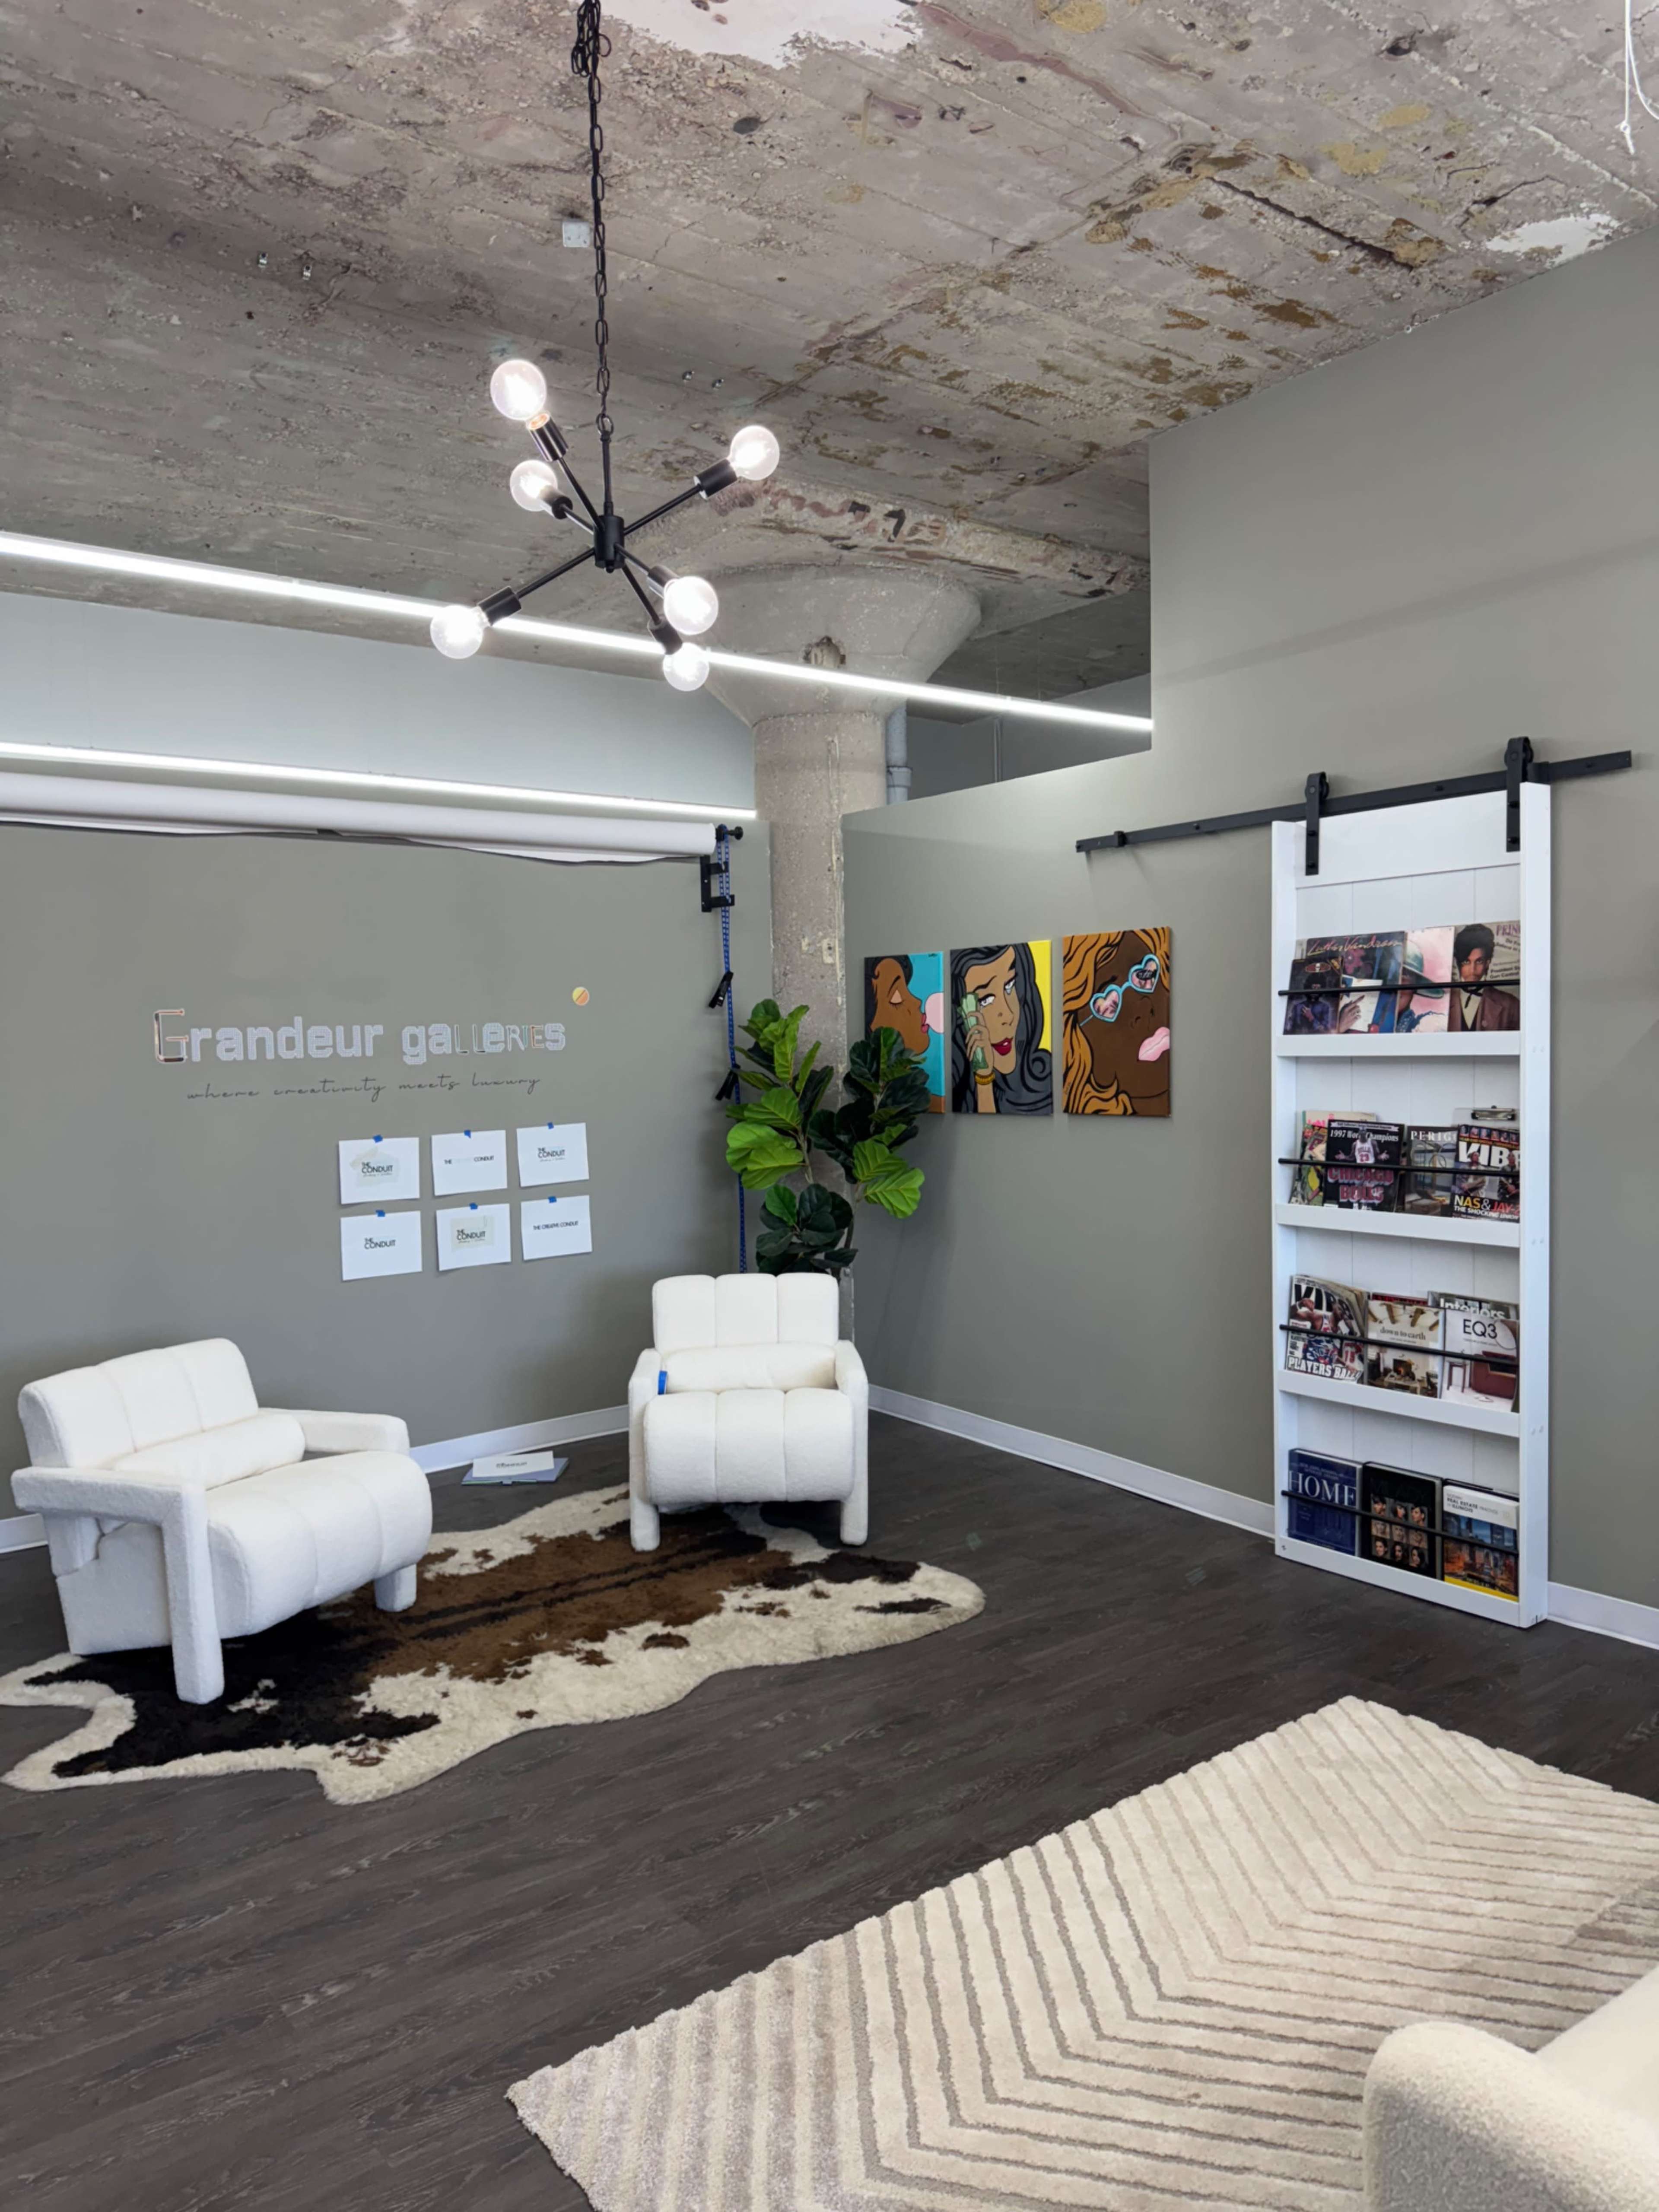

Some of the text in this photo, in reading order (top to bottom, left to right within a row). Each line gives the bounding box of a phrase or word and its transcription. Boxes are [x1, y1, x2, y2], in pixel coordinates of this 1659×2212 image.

[153, 1008, 384, 1063] Grandeur
[187, 1072, 541, 1102] where creativity meets luxury
[1330, 1129, 1345, 1138] 1997
[1366, 1131, 1399, 1143] Champions
[537, 1150, 565, 1158] CONDUIT
[362, 1165, 393, 1173] CONDUIT
[1327, 1167, 1394, 1185] CHICAGO
[1340, 1185, 1384, 1203] BULLS
[1454, 1195, 1481, 1209] NAS
[1481, 1198, 1491, 1210] &
[457, 1231, 485, 1240] CONDUIT
[364, 1239, 396, 1249] CONDUIT
[1440, 1298, 1505, 1319] Interiors
[1380, 1326, 1398, 1336] down
[1408, 1332, 1426, 1340] earth
[1463, 1318, 1497, 1339] EQ3
[1288, 1356, 1332, 1377] PLAYERS
[1289, 1470, 1356, 1508] HOME
[1460, 1501, 1478, 1509] ESTATE
